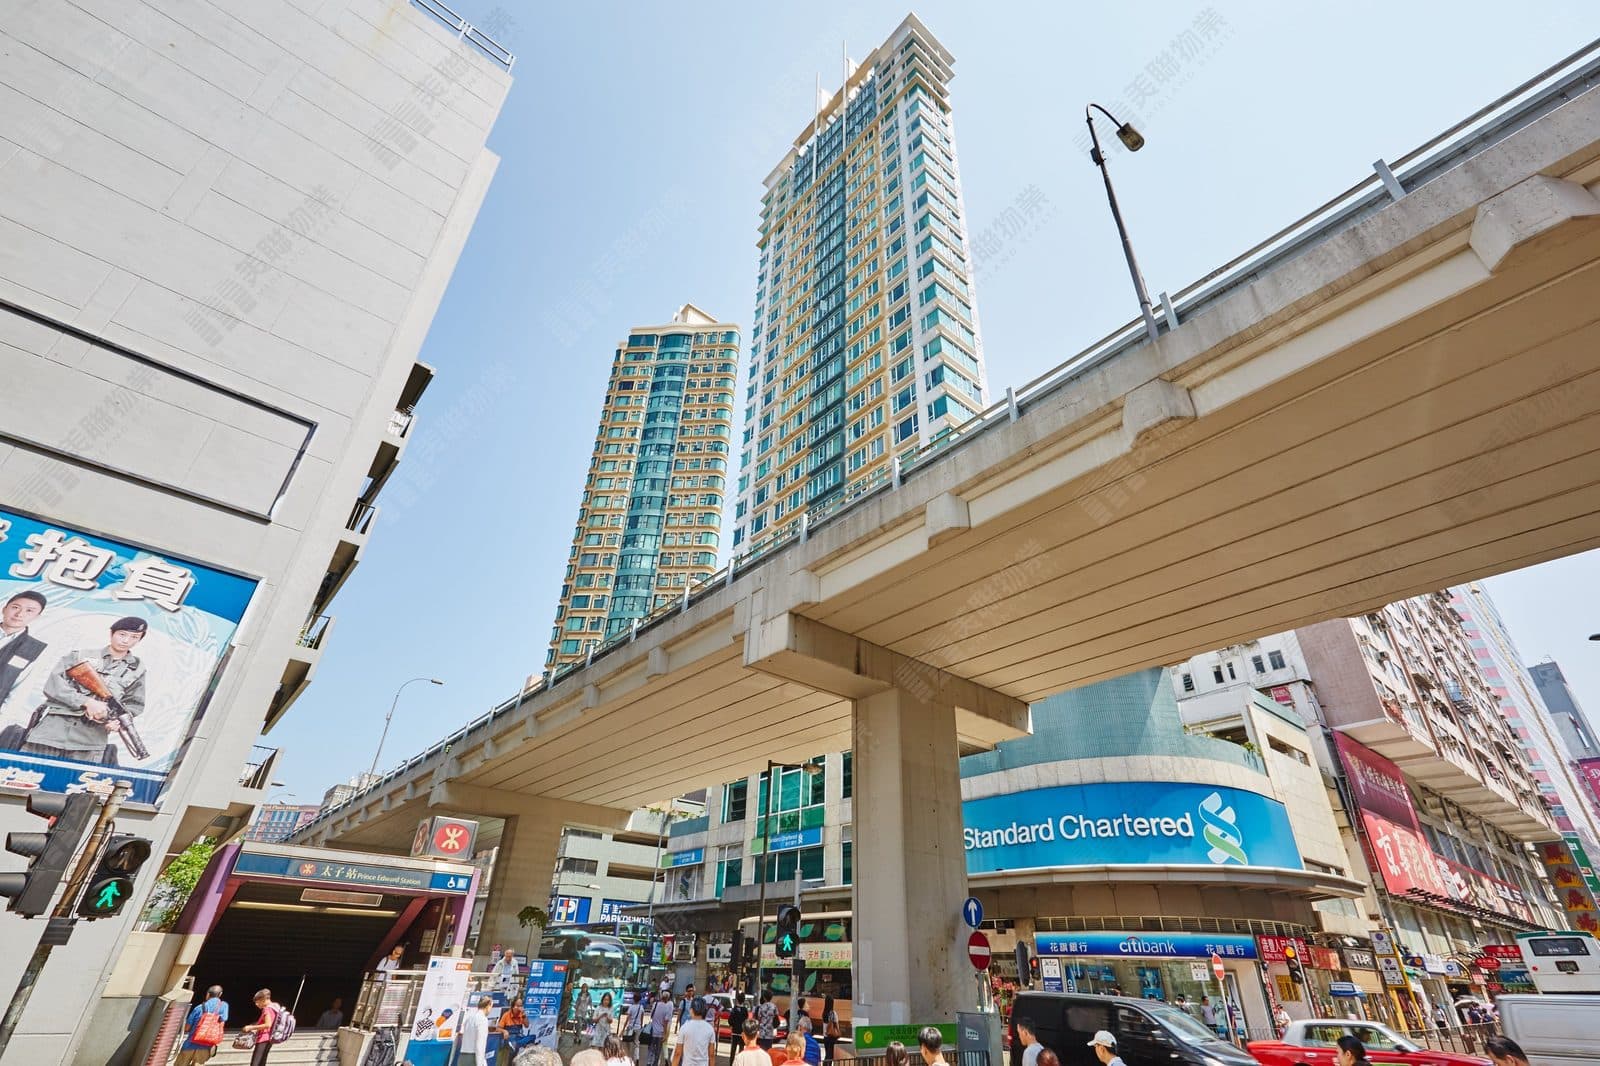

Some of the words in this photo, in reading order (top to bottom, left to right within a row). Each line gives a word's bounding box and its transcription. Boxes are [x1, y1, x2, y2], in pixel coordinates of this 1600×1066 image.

[963, 817, 1055, 850] Standard
[1059, 811, 1195, 841] Chartered
[320, 865, 357, 880] 太子站
[357, 871, 377, 882] Prince
[377, 873, 397, 884] Edward
[397, 875, 422, 887] Station
[1119, 936, 1177, 954] citibank
